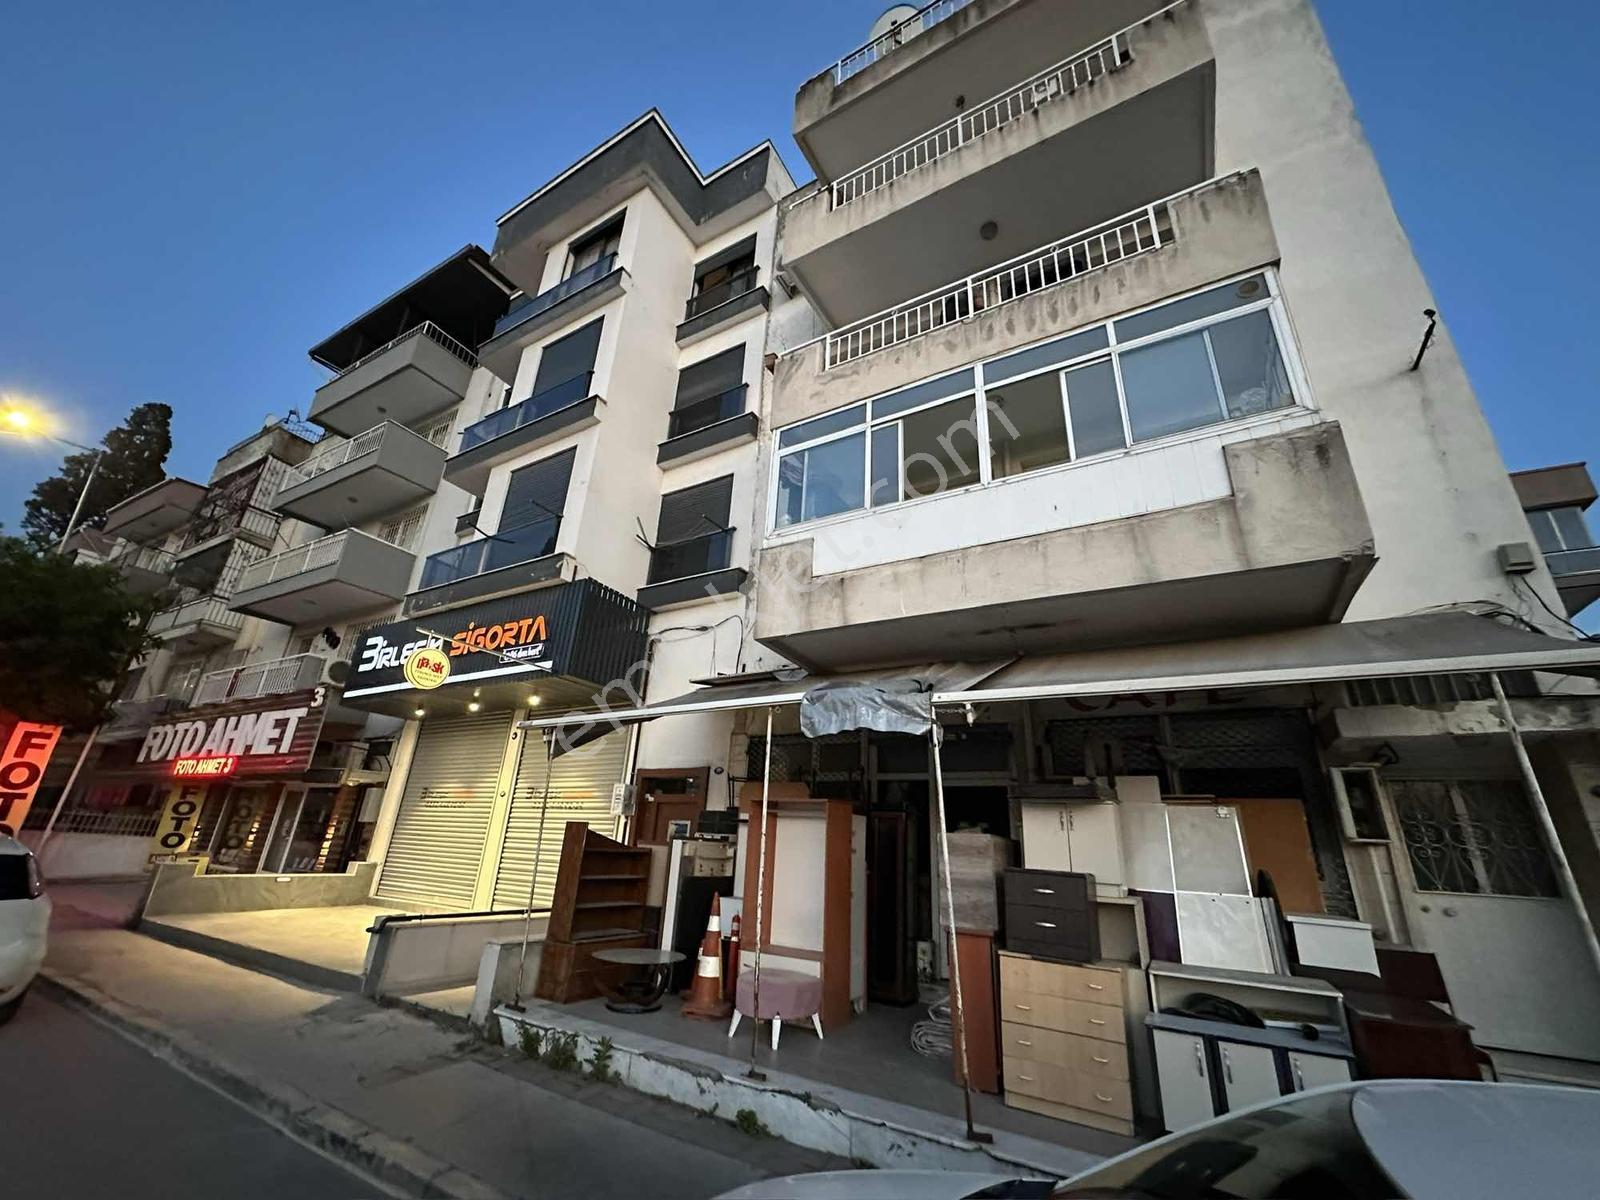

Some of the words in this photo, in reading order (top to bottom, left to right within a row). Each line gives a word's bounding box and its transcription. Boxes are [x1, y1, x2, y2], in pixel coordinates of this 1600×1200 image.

[449, 615, 547, 657] SİGORTA
[136, 720, 207, 763] FOTO
[200, 707, 308, 757] AHMET
[310, 687, 326, 707] 3
[173, 759, 198, 776] FOTO
[193, 757, 228, 775] AHMET
[223, 757, 234, 774] 3
[160, 785, 201, 849] FOTO
